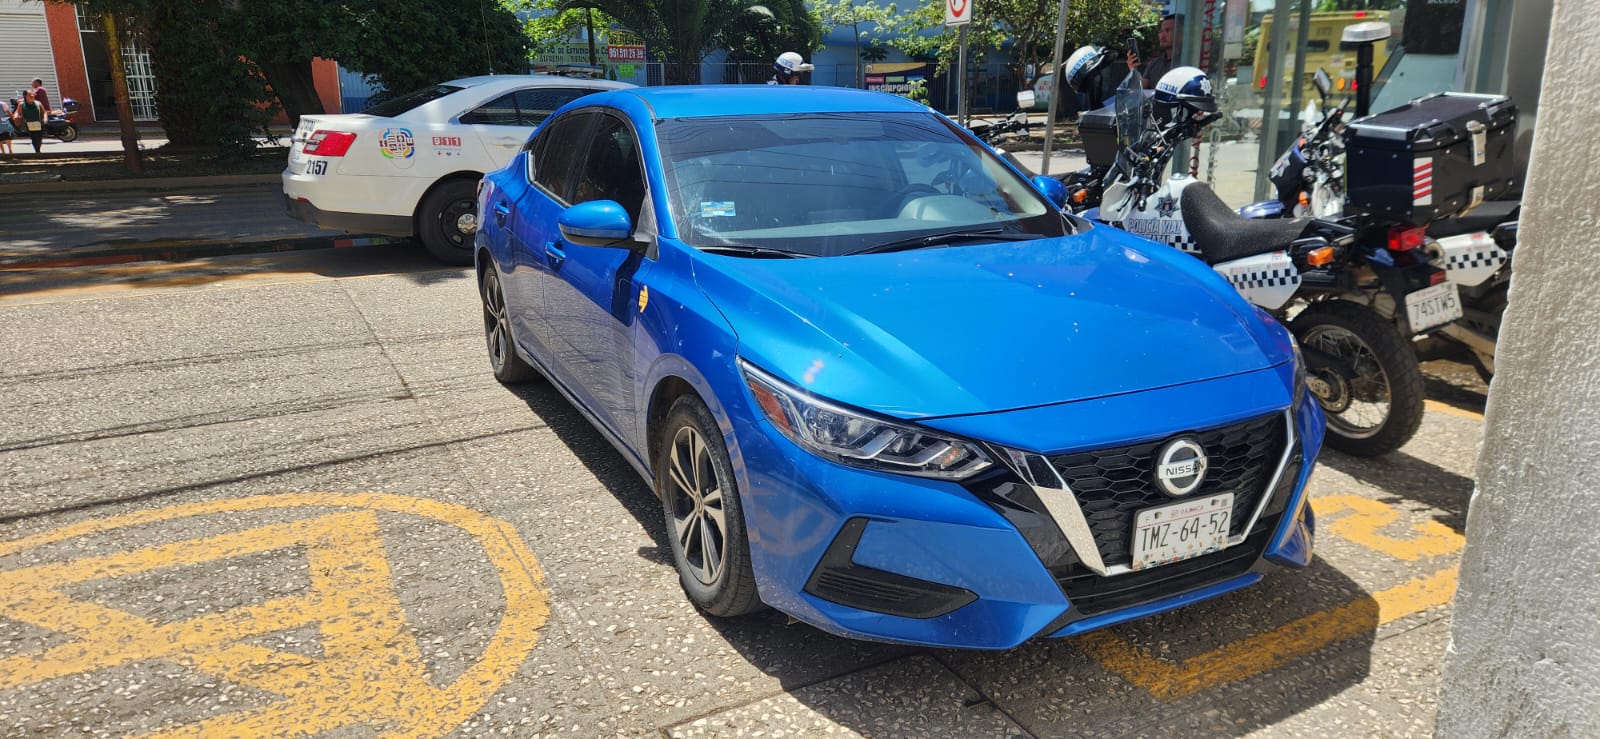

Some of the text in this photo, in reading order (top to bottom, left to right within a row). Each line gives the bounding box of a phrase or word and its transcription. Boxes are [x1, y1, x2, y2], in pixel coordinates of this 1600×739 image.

[433, 137, 461, 146] 911
[306, 160, 328, 175] 2157
[1161, 219, 1182, 234] VIAL
[1414, 294, 1455, 318] 74STW5
[1165, 462, 1204, 475] NISSAN
[1142, 511, 1229, 552] TMZ-64-52
